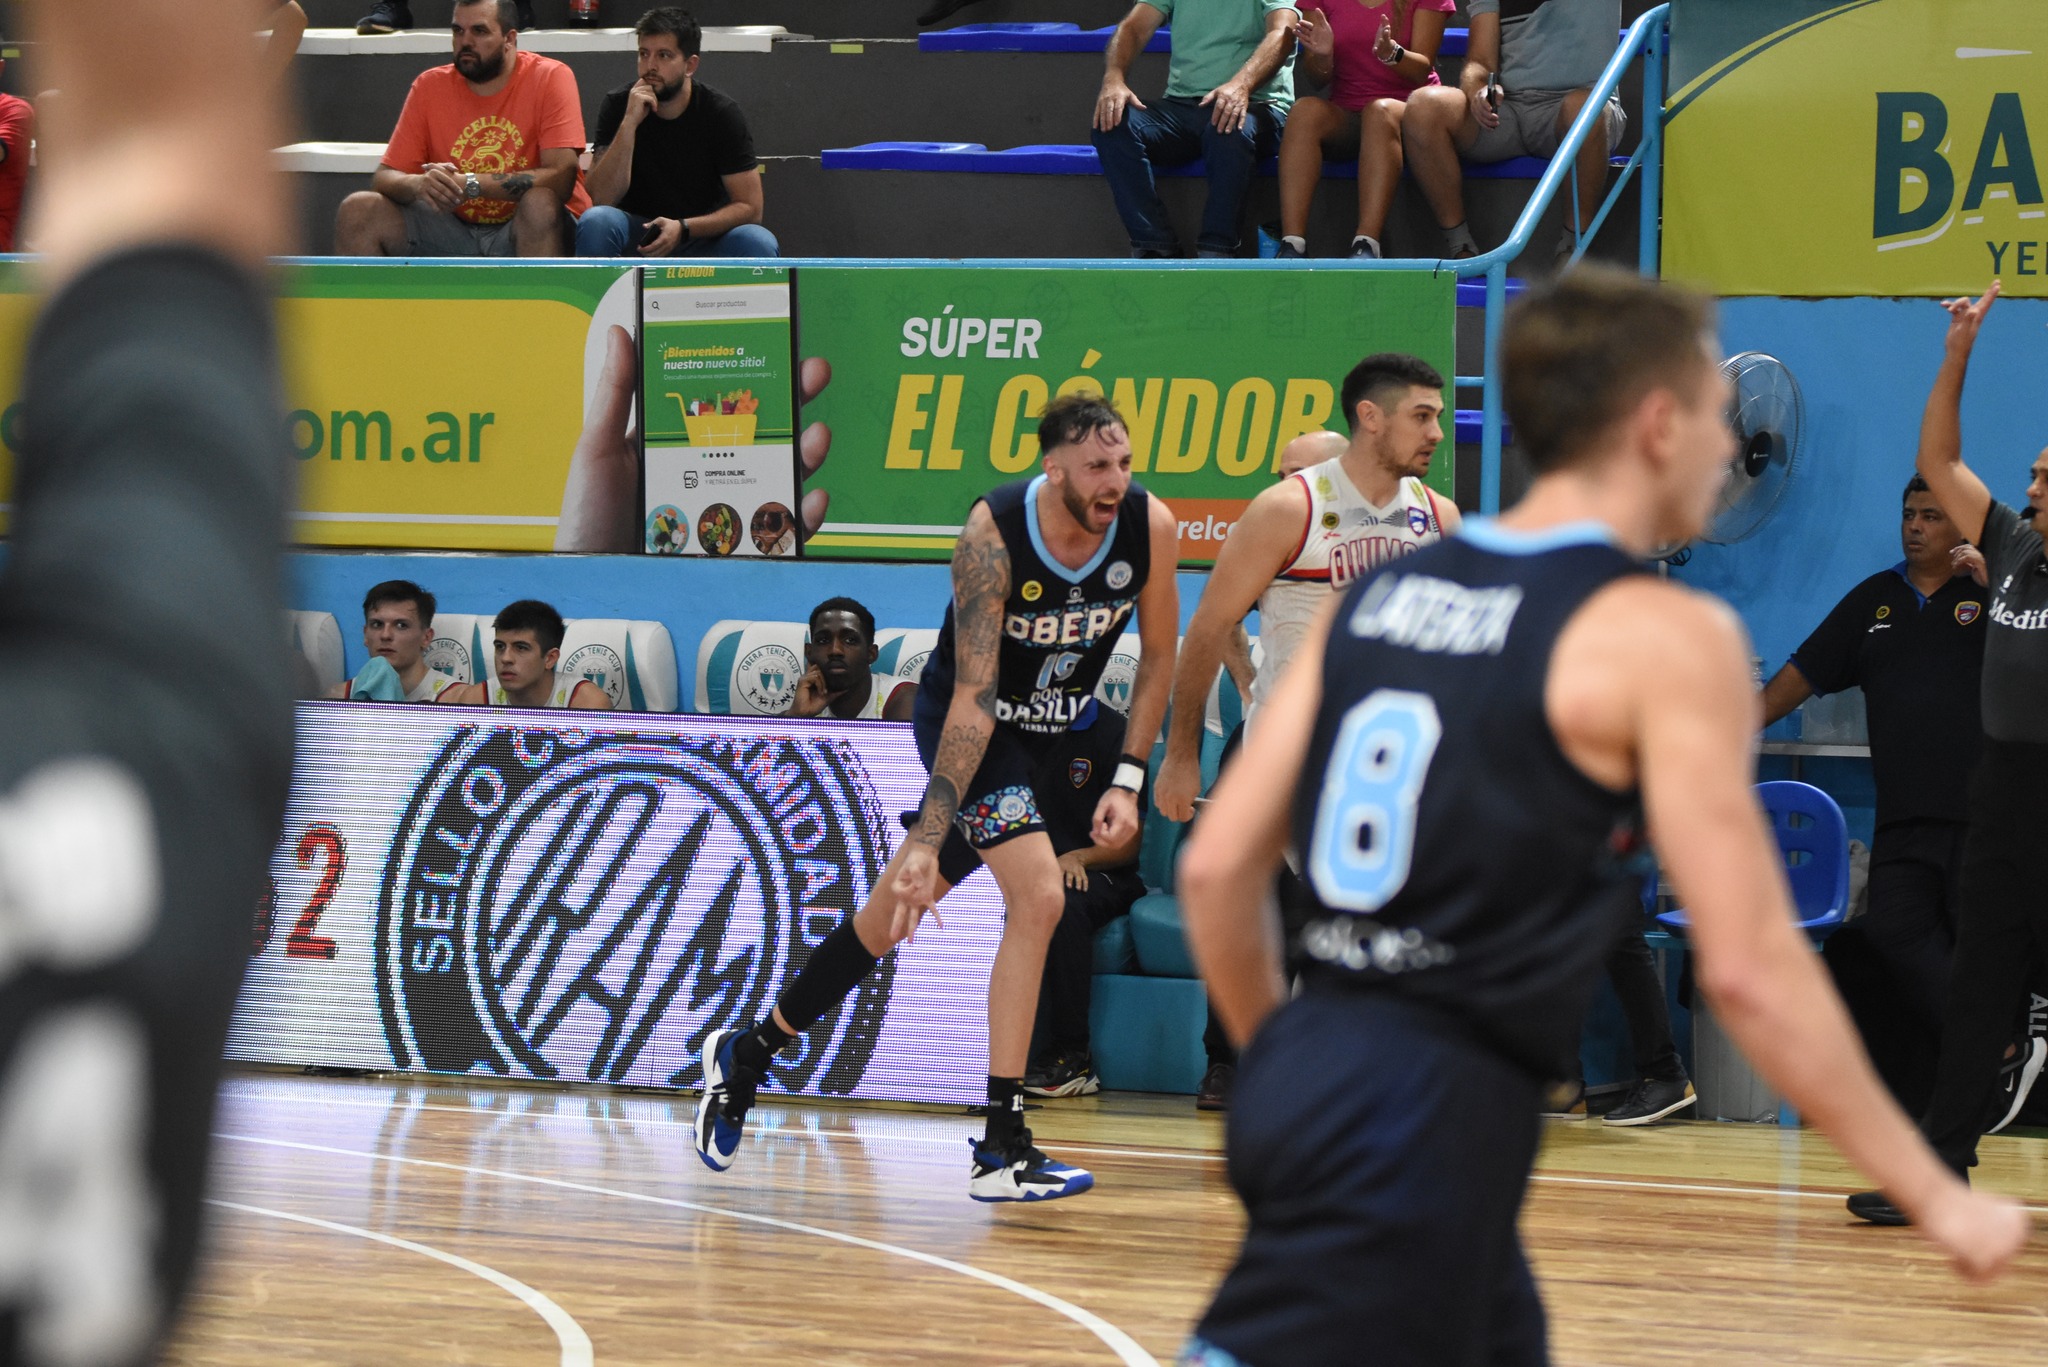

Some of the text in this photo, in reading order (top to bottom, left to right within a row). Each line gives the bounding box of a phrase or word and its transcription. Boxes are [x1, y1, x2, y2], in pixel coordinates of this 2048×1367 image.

[695, 301, 747, 309] Buscar productos
[900, 304, 1043, 359] SÚPER
[663, 356, 766, 370] nuestro nuevo sitio!
[736, 347, 745, 356] a
[884, 373, 965, 471] EL
[436, 640, 469, 666] TENIS CLUB
[587, 646, 608, 657] TENIS
[608, 653, 621, 673] CLUB
[741, 646, 800, 674] OBERA TENIS CLUB
[902, 655, 925, 677] OBERA
[1109, 656, 1132, 667] TENIS
[1030, 687, 1064, 704] DON
[1308, 687, 1444, 913] 8
[412, 763, 507, 974] SELLO
